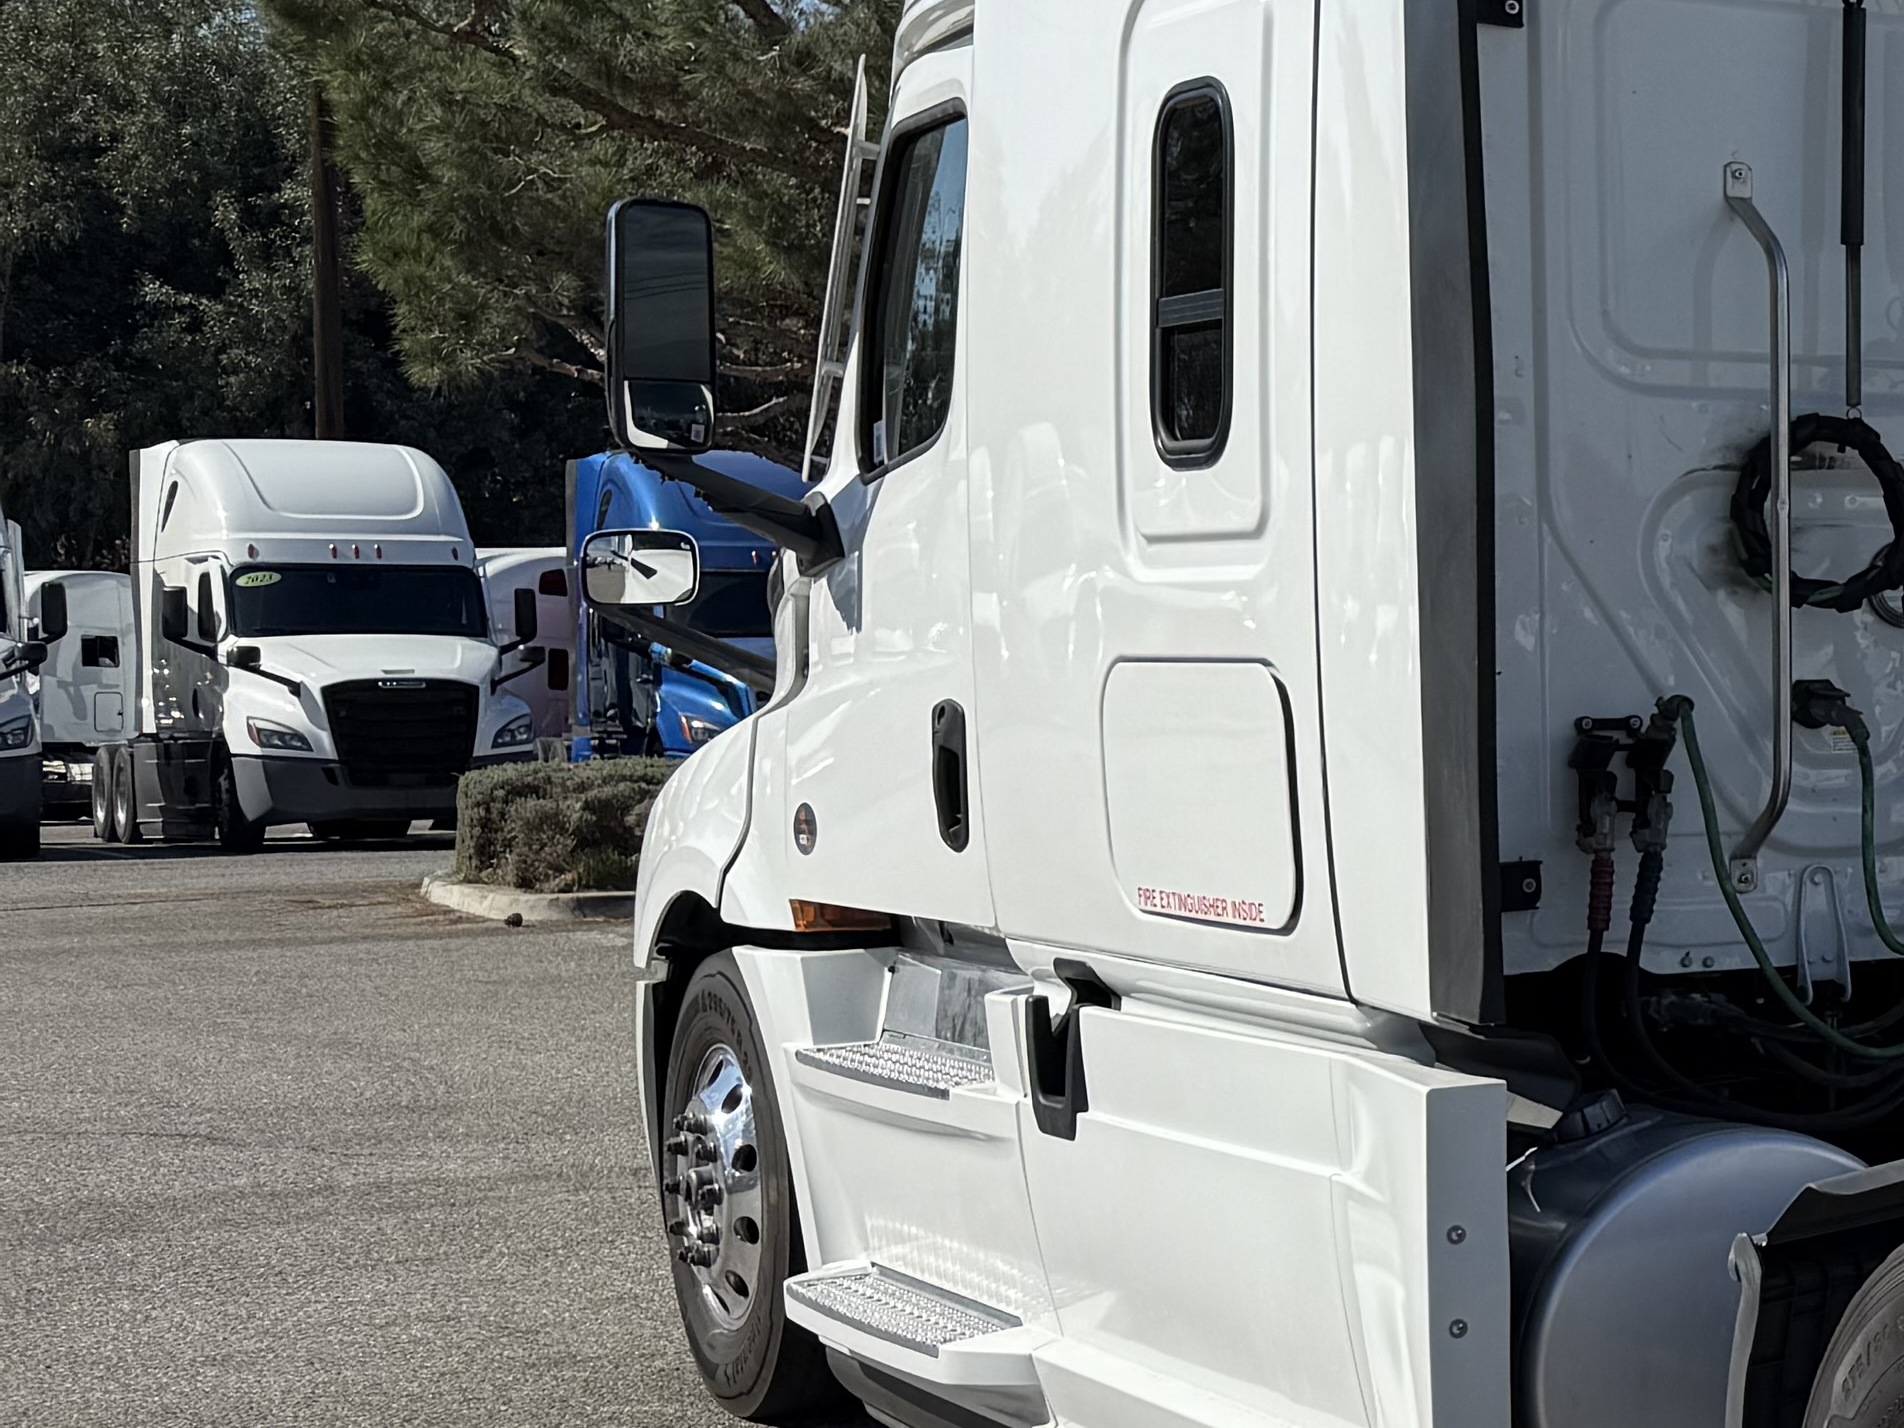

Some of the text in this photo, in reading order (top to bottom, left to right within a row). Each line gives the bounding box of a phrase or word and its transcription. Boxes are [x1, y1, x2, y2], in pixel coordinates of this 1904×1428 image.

[1137, 886, 1265, 922] FIRE EXTINGUISHER INSIDE
